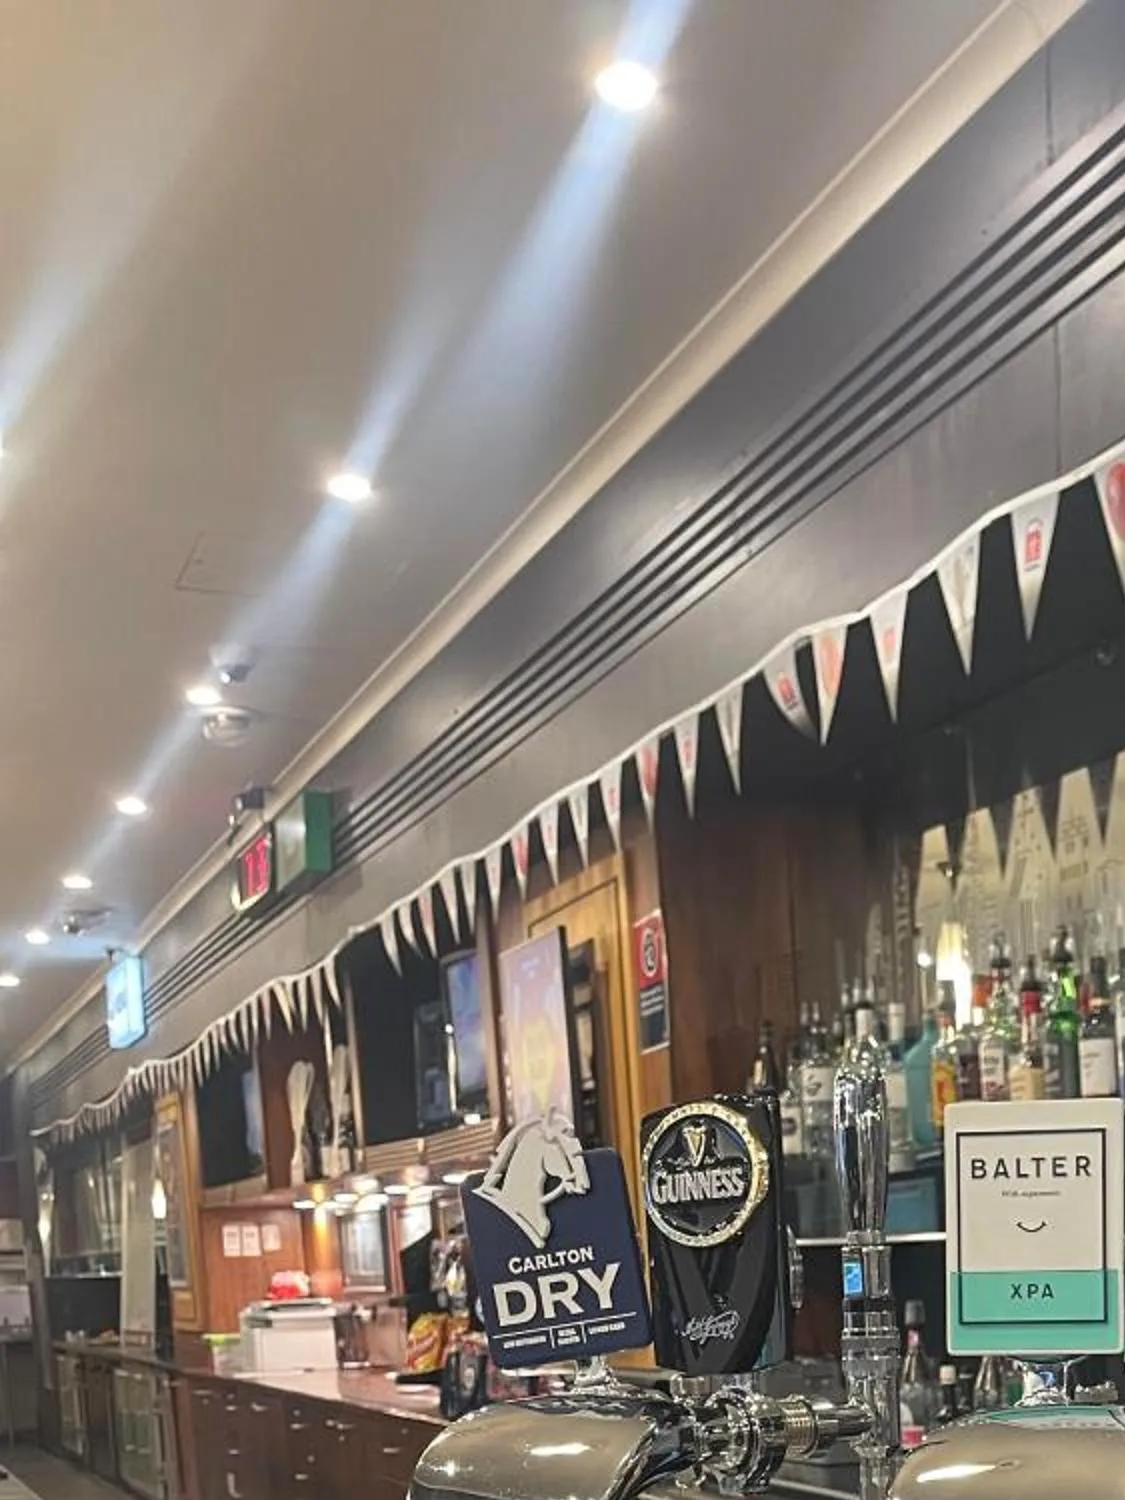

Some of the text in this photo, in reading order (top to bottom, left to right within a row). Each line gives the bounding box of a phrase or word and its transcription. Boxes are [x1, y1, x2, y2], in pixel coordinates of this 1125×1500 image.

[971, 1155, 1091, 1179] BALTER
[652, 1167, 745, 1203] GUINNESS
[508, 1246, 594, 1274] CARLTON
[492, 1261, 621, 1327] DRY
[1011, 1283, 1055, 1300] XPA
